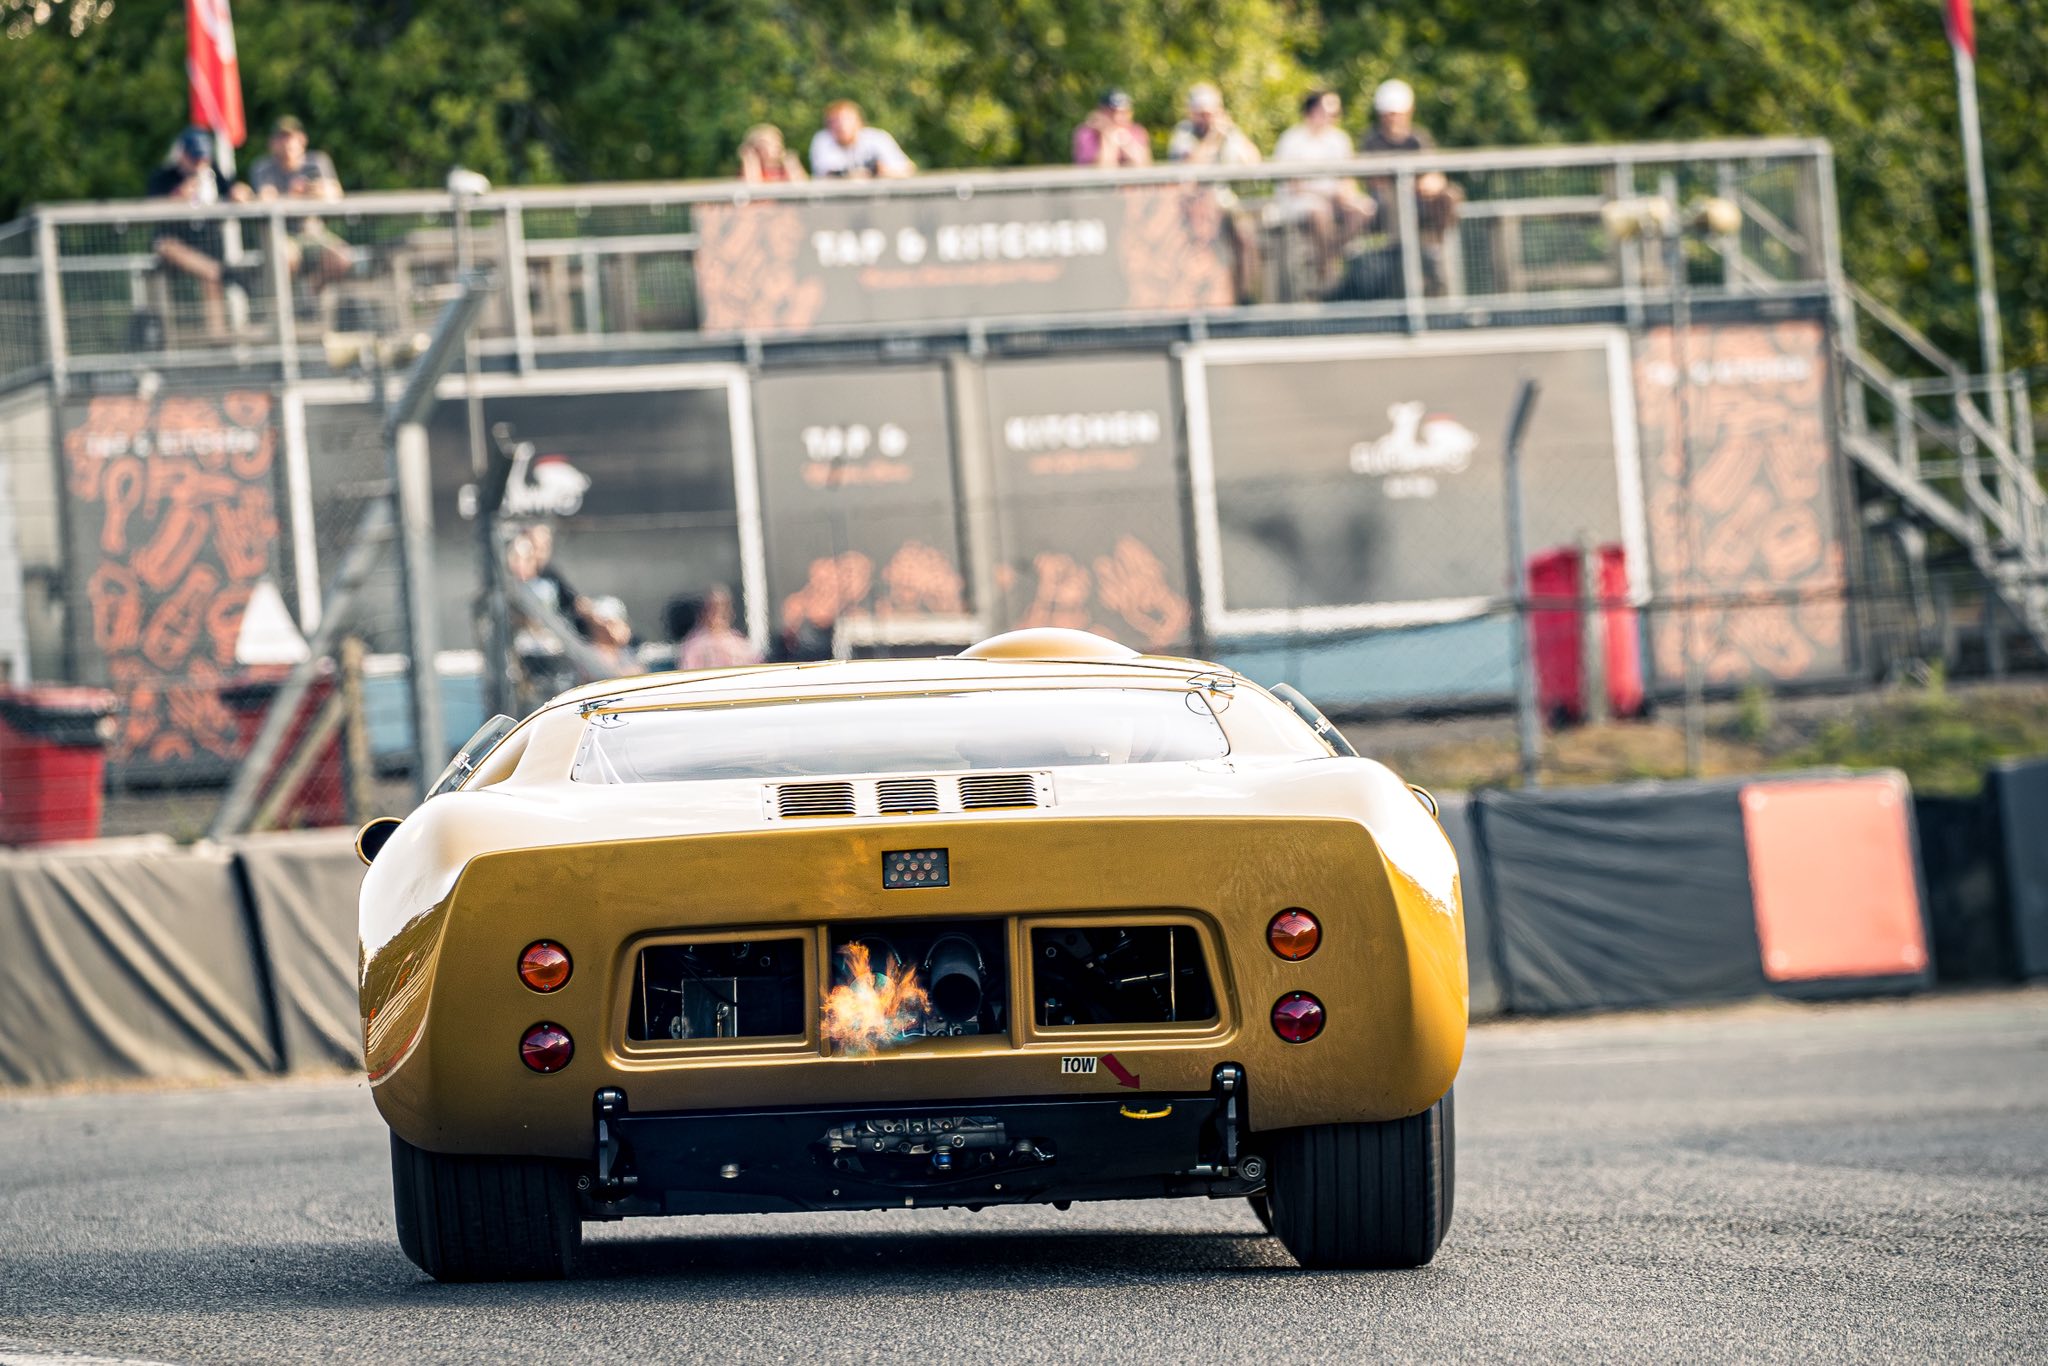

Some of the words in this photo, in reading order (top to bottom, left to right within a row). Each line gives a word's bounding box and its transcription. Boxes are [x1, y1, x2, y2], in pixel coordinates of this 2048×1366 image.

[813, 229, 885, 267] TAP
[938, 220, 1106, 260] KITCHEN
[1063, 1057, 1095, 1073] TOW
